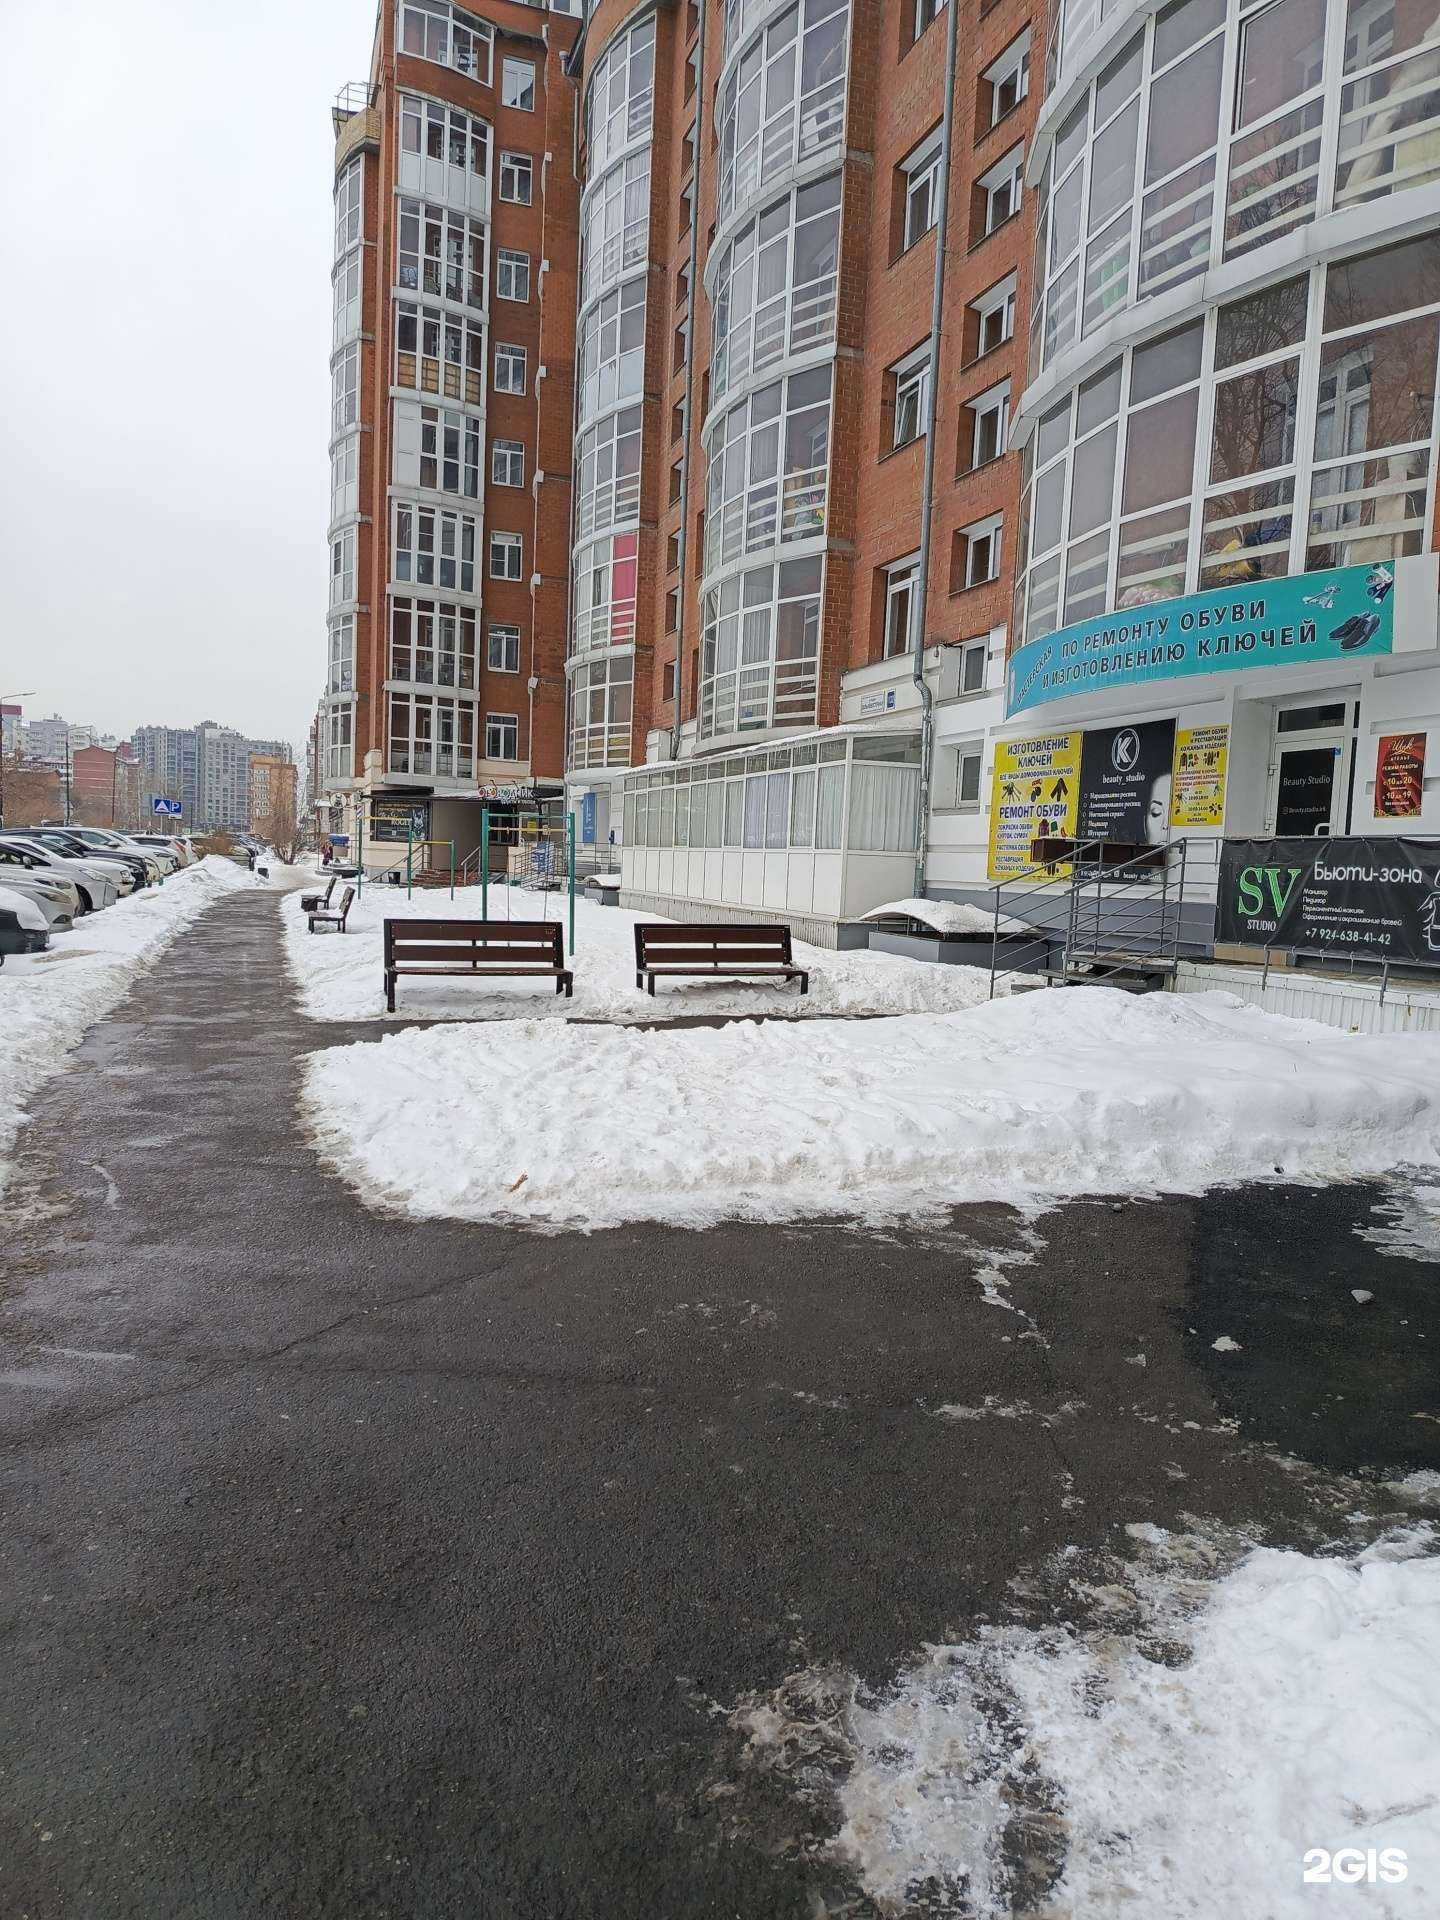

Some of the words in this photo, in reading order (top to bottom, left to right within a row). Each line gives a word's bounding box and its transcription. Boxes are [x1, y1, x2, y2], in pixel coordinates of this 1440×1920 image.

[1062, 640, 1078, 659] ПО
[1084, 616, 1170, 652] РЕМОНТУ
[1180, 599, 1266, 631] ОБУВИ
[1042, 672, 1049, 689] И
[1052, 643, 1185, 686] ИЗГОТОВЛЕНИЮ
[1198, 619, 1316, 657] КЛЮЧЕЙ
[1008, 736, 1070, 756] ИЗГОТОВЛЕНИЕ
[1017, 751, 1052, 768] КЛЮЧЕЙ
[1283, 777, 1307, 787] Beauty
[1308, 774, 1330, 785] Studio
[1387, 777, 1396, 785] 10
[1403, 776, 1412, 784] 20
[1000, 805, 1034, 818] РЕМОНТ
[1036, 803, 1067, 818] ОБУВИ
[1313, 861, 1423, 884] Бьюти-зона
[1238, 866, 1302, 918] SV
[1246, 919, 1277, 932] STUDIO
[1305, 928, 1317, 938] +7
[1320, 929, 1391, 945] 924-638-41-42
